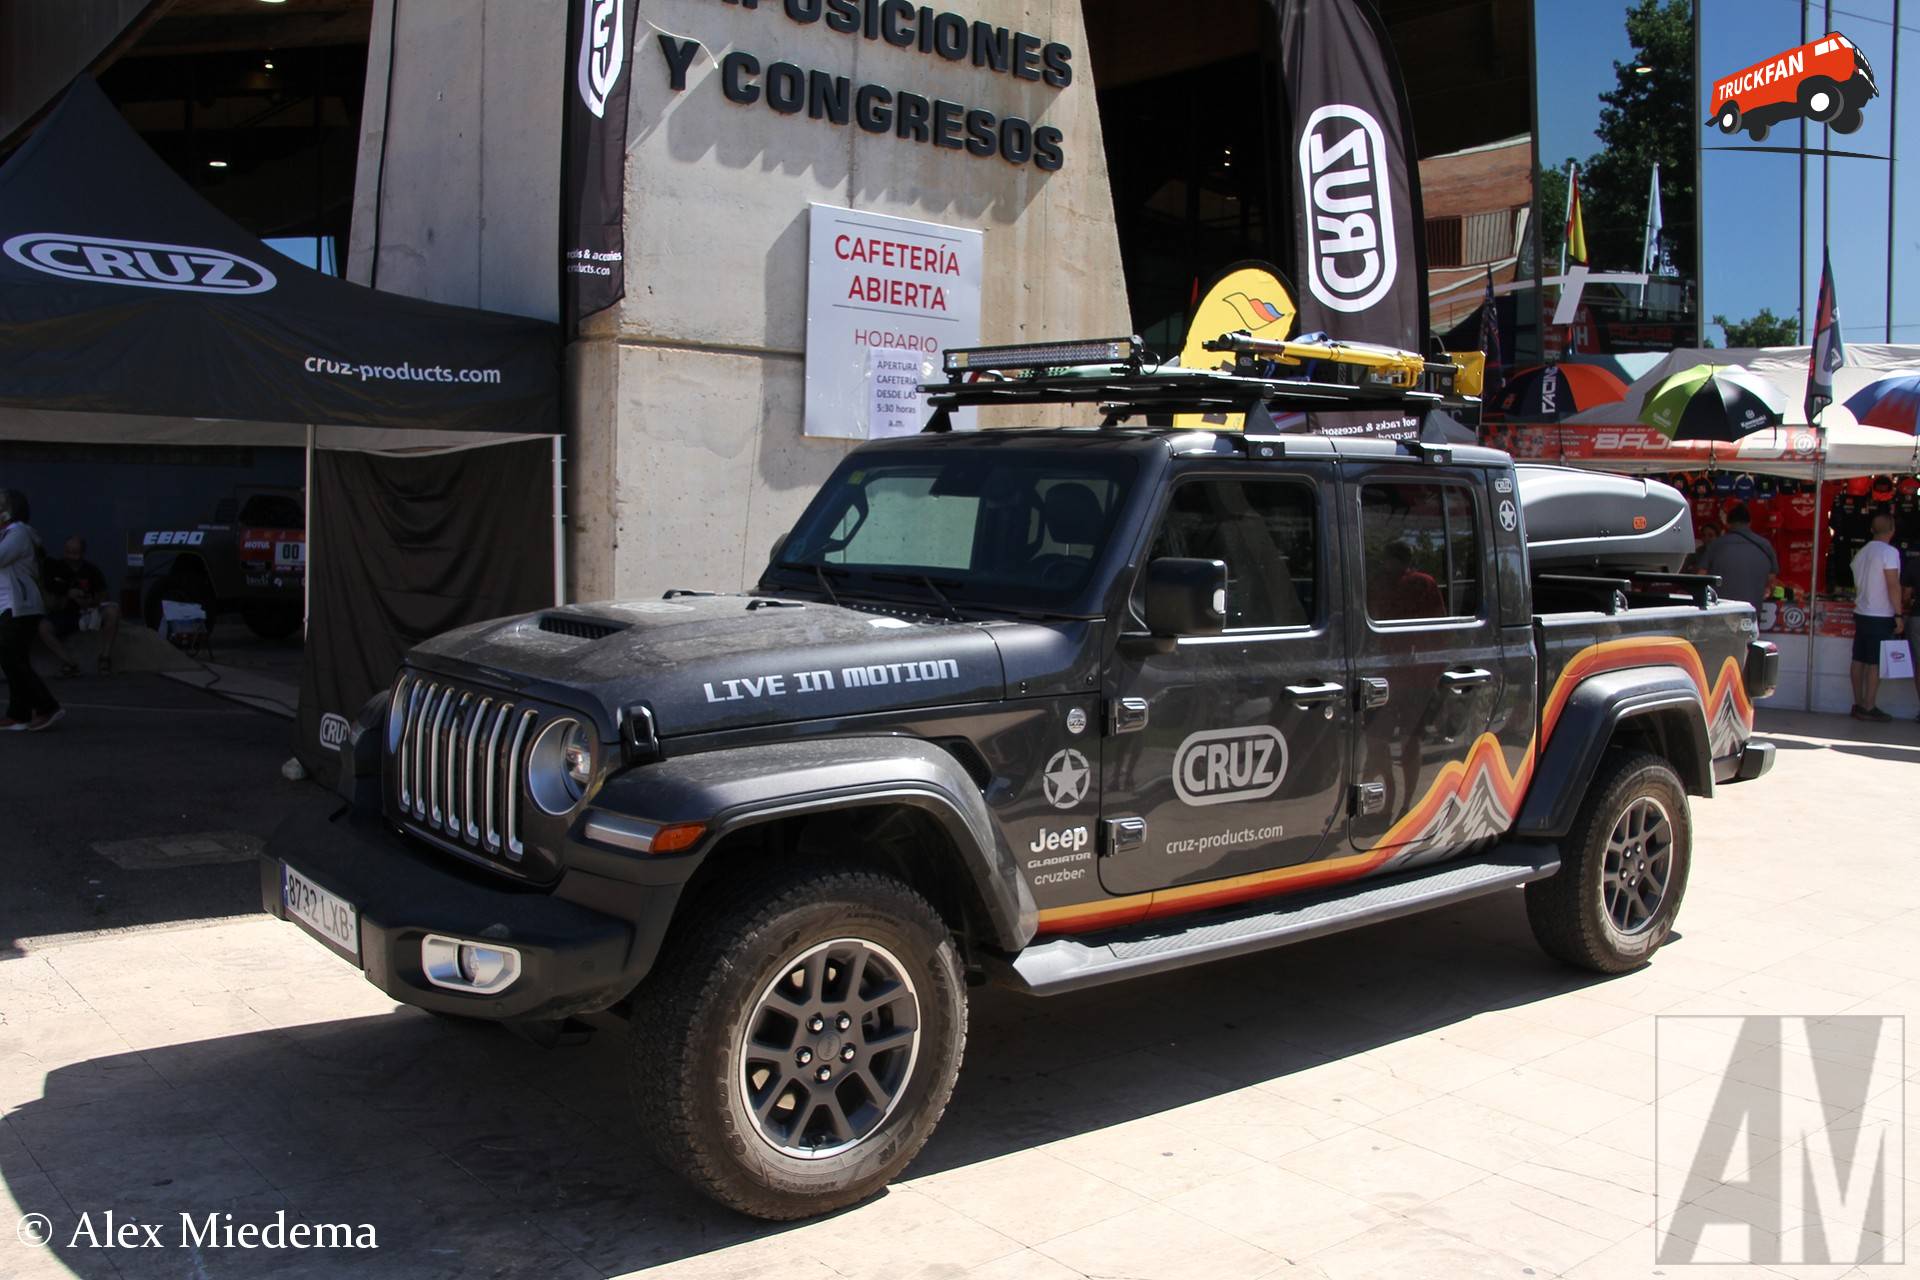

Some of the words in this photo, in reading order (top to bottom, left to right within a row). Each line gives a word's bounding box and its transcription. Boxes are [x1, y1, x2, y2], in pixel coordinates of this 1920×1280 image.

[722, 0, 1073, 88] OSICIONES
[657, 34, 701, 91] Y
[722, 51, 1064, 171] CONGRESOS
[31, 242, 250, 287] CRUZ
[835, 234, 960, 276] CAFETERÍA
[848, 275, 946, 311] ABIERTA
[855, 329, 938, 353] HORARIO
[304, 355, 501, 384] cruz-products.com
[876, 375, 918, 385] CAFETERÍA
[877, 361, 918, 371] APERTURA
[876, 389, 902, 399] DESDE
[903, 391, 917, 400] LAS
[895, 403, 916, 414] horas
[1594, 433, 1694, 450] BAJ
[704, 675, 786, 703] LIVE
[793, 670, 835, 693] IN
[842, 659, 959, 688] MOTION
[1183, 738, 1275, 792] CRUZ
[1030, 826, 1088, 853] Jeep
[1166, 825, 1284, 854] cruz-products.com
[1027, 852, 1092, 869] GLADIATOR
[1034, 868, 1086, 886] cruzber
[288, 874, 319, 923] 8732
[321, 895, 350, 942] LXB
